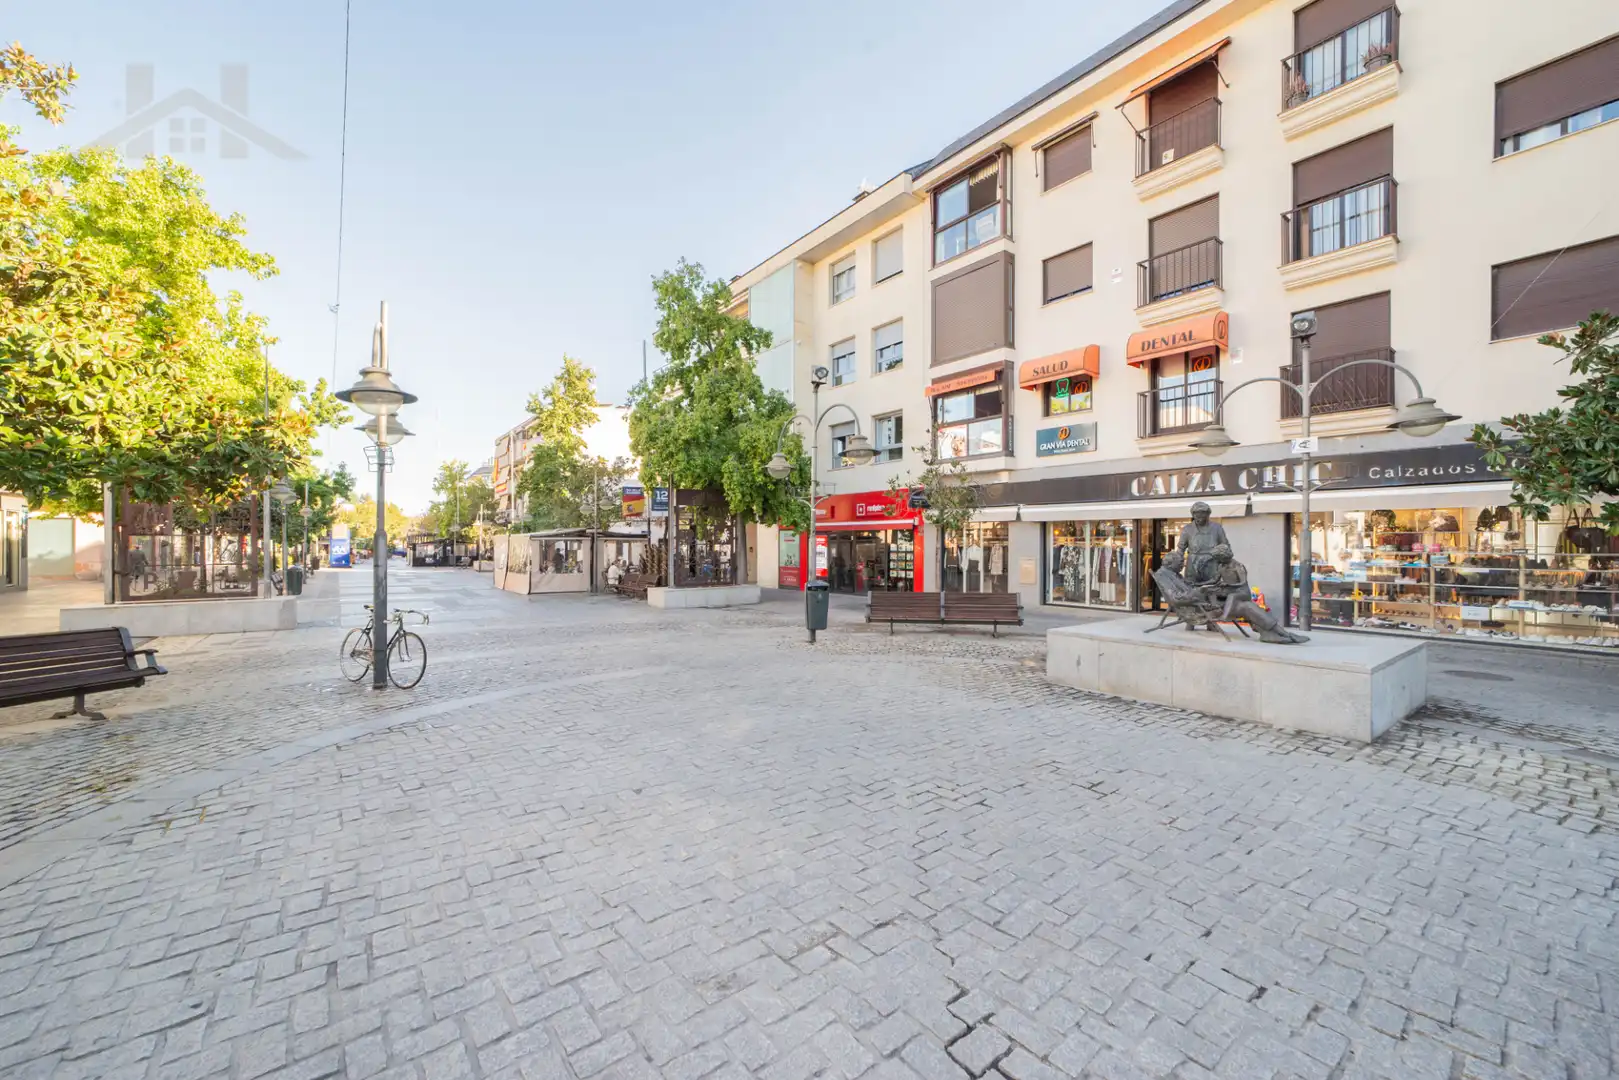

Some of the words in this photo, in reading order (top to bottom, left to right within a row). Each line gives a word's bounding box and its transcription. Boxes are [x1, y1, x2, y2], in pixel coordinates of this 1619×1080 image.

[1141, 330, 1196, 352] DENTAL
[1033, 360, 1068, 377] SALUD
[1067, 438, 1090, 447] DENTAL
[1131, 471, 1225, 496] CALZA
[1238, 462, 1333, 490] CHIC
[655, 490, 669, 500] 12
